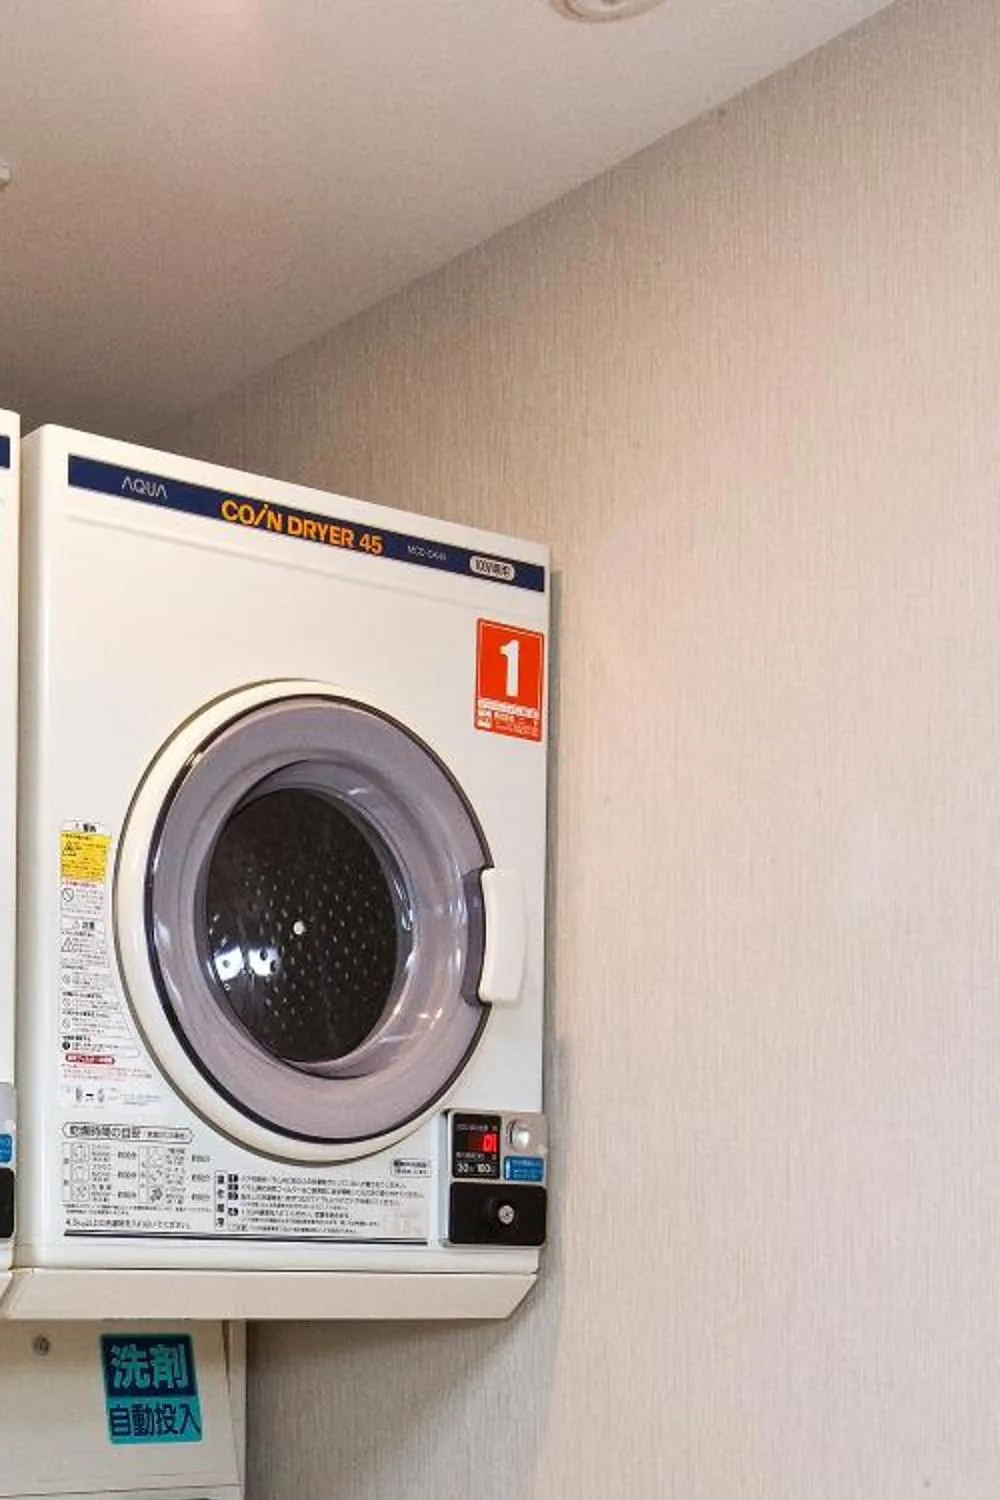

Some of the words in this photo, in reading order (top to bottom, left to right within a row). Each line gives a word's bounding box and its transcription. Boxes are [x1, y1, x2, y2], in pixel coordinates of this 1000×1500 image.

[120, 475, 169, 500] AQUA
[287, 515, 355, 548] DRYER
[359, 533, 384, 555] 45
[499, 639, 520, 698] 1
[110, 1343, 189, 1390] 洗剤
[109, 1403, 201, 1437] 自動投入
